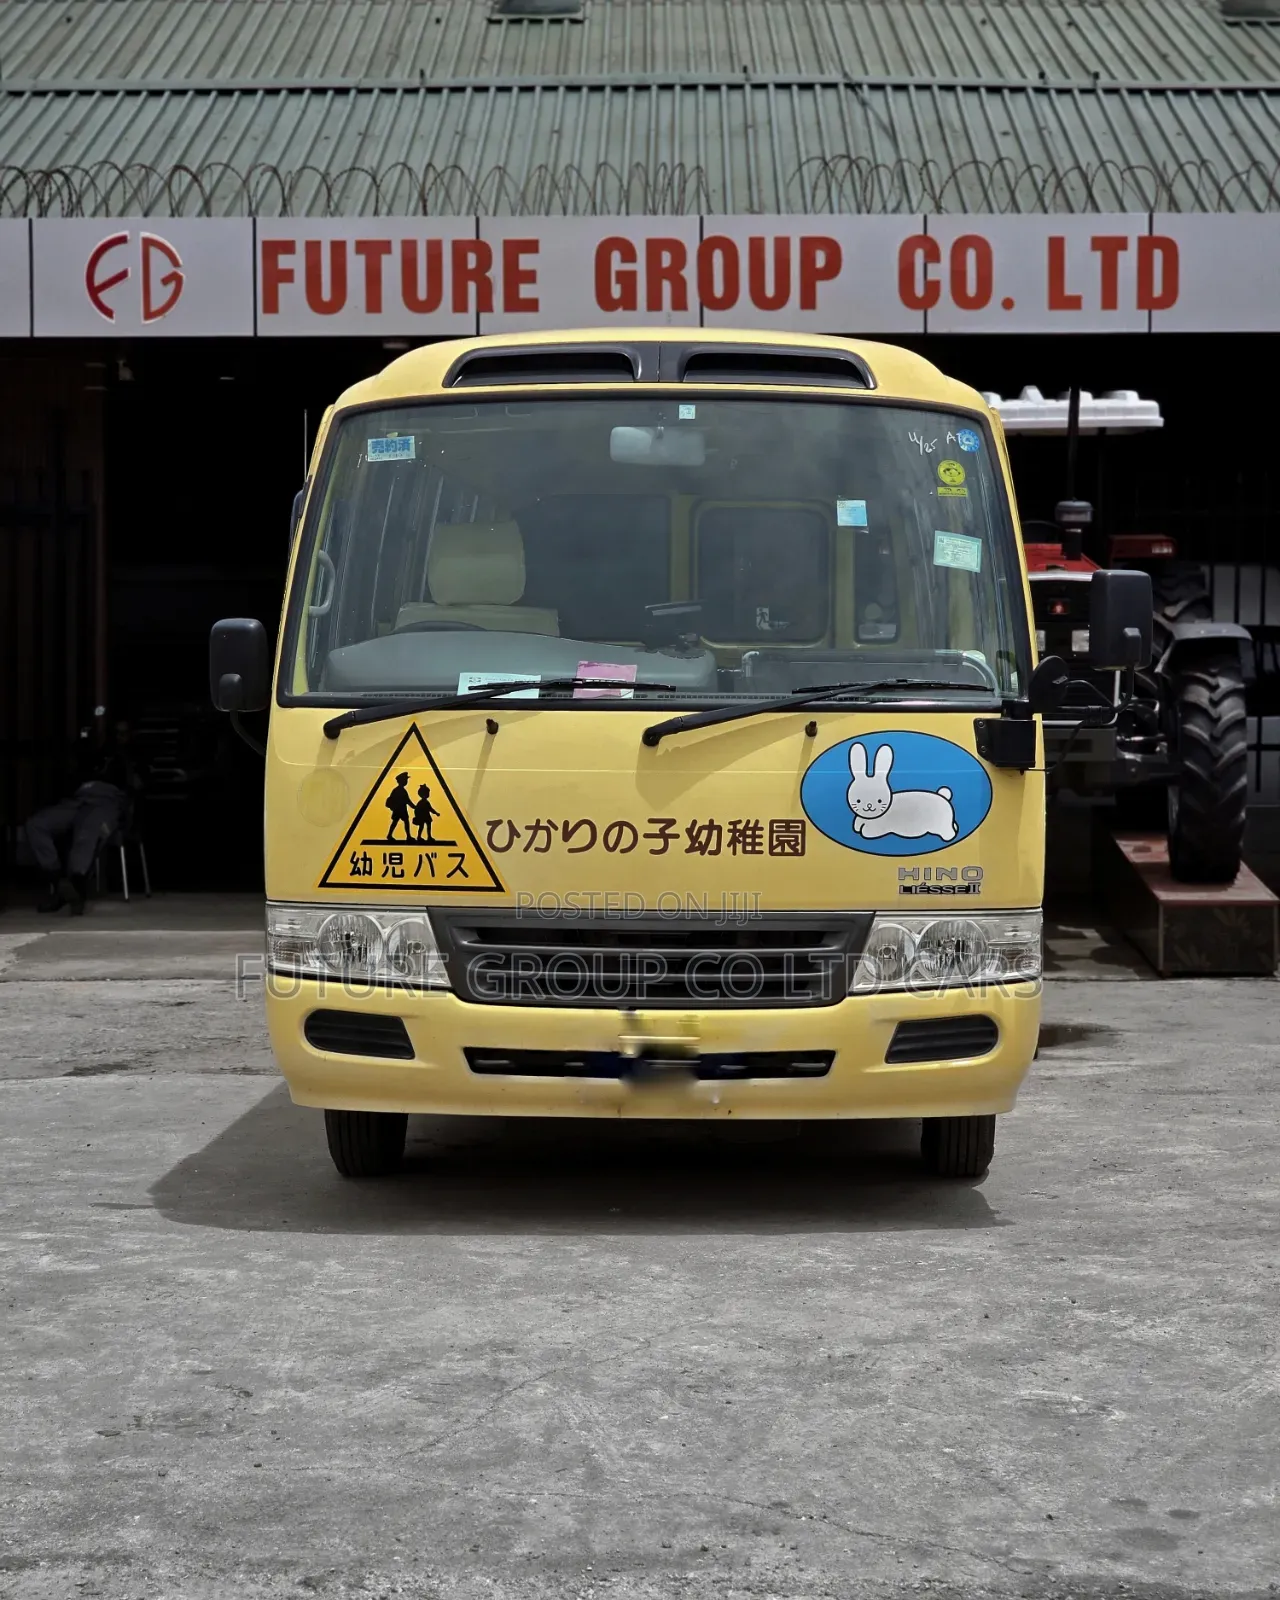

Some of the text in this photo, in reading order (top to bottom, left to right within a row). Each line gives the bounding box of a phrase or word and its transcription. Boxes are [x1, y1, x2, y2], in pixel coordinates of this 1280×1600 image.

[261, 234, 1181, 314] FUTURE GROUP CO. LTD
[486, 817, 806, 856] ひかりの子幼稚園
[349, 851, 470, 879] 幼児バス
[898, 866, 983, 881] HINO
